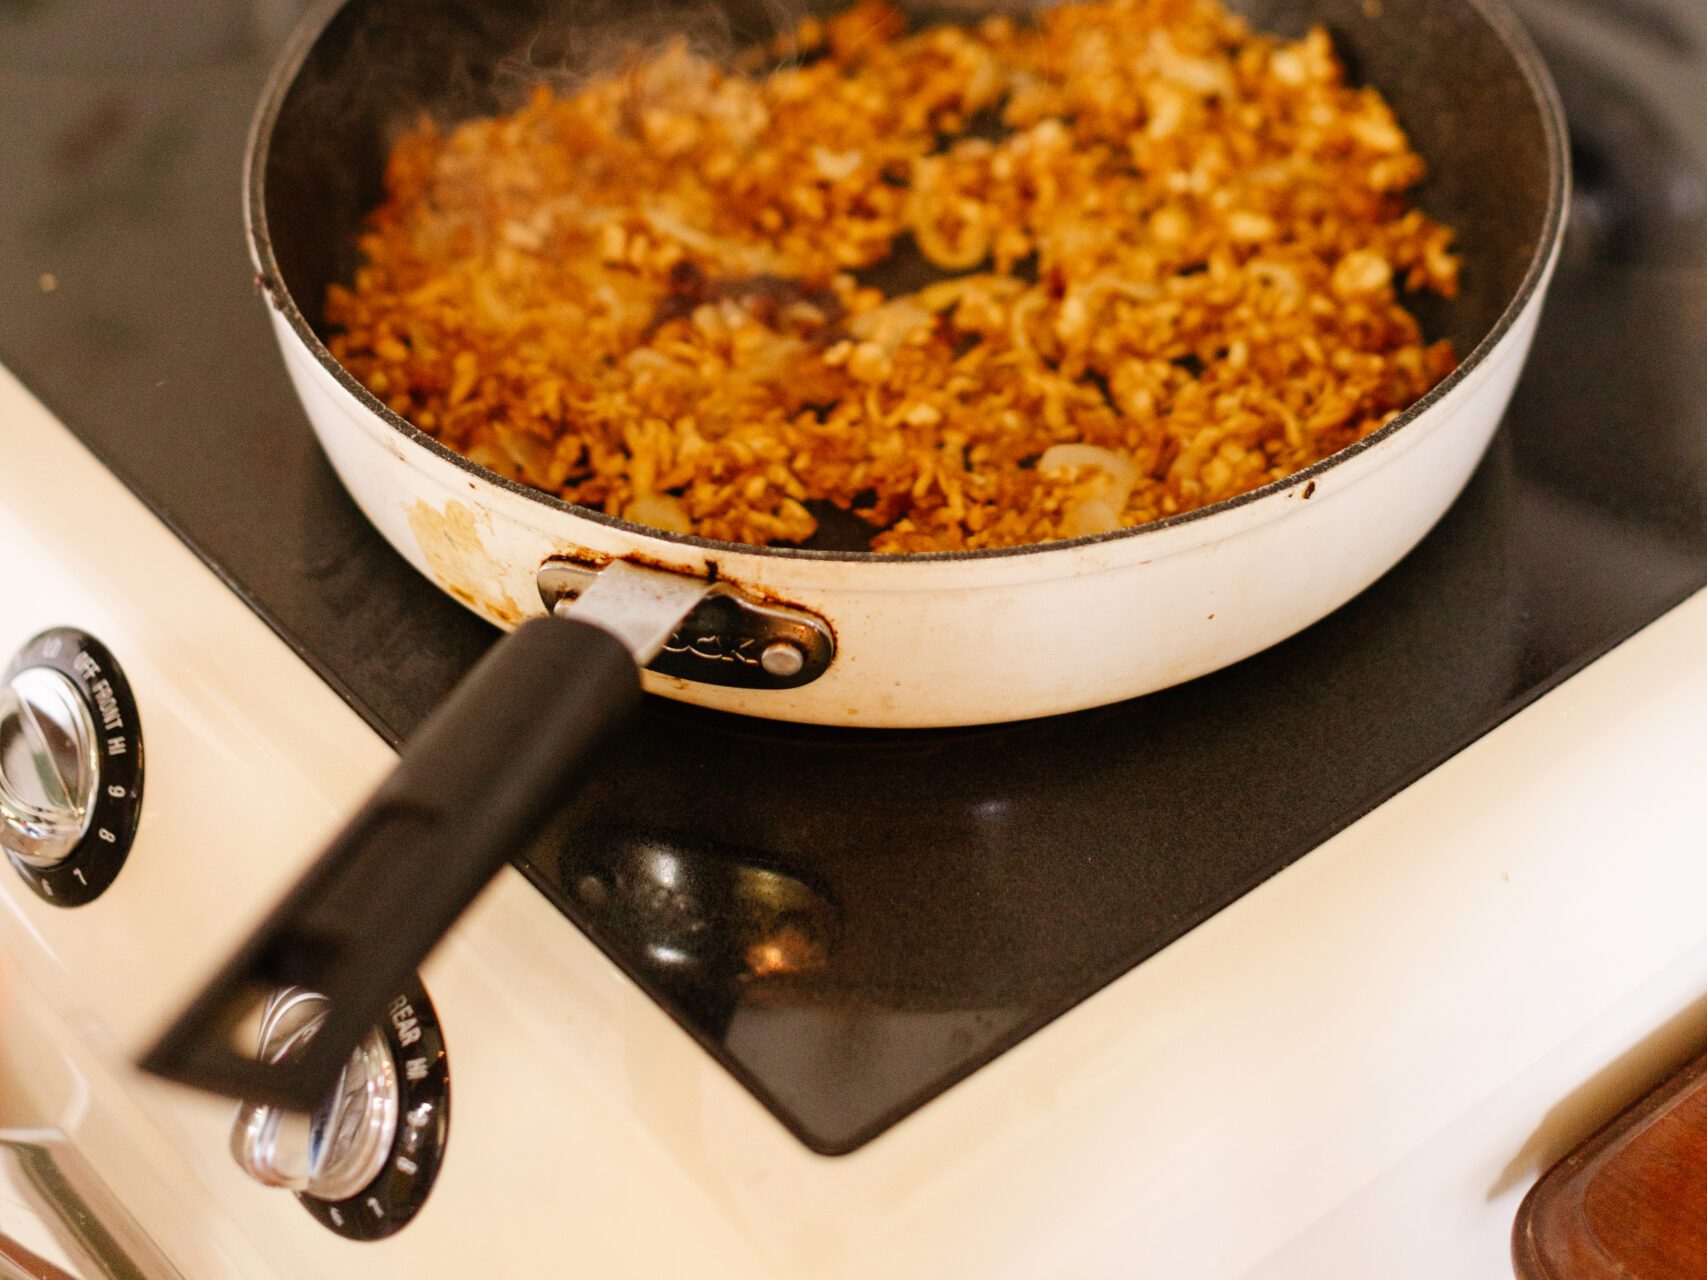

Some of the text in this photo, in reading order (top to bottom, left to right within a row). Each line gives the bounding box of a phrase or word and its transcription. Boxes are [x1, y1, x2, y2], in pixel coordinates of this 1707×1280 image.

[73, 650, 127, 756] OFF FRONT HI
[107, 785, 126, 798] 9
[98, 827, 116, 843] 8
[73, 867, 87, 886] 7
[389, 994, 422, 1048] REAR
